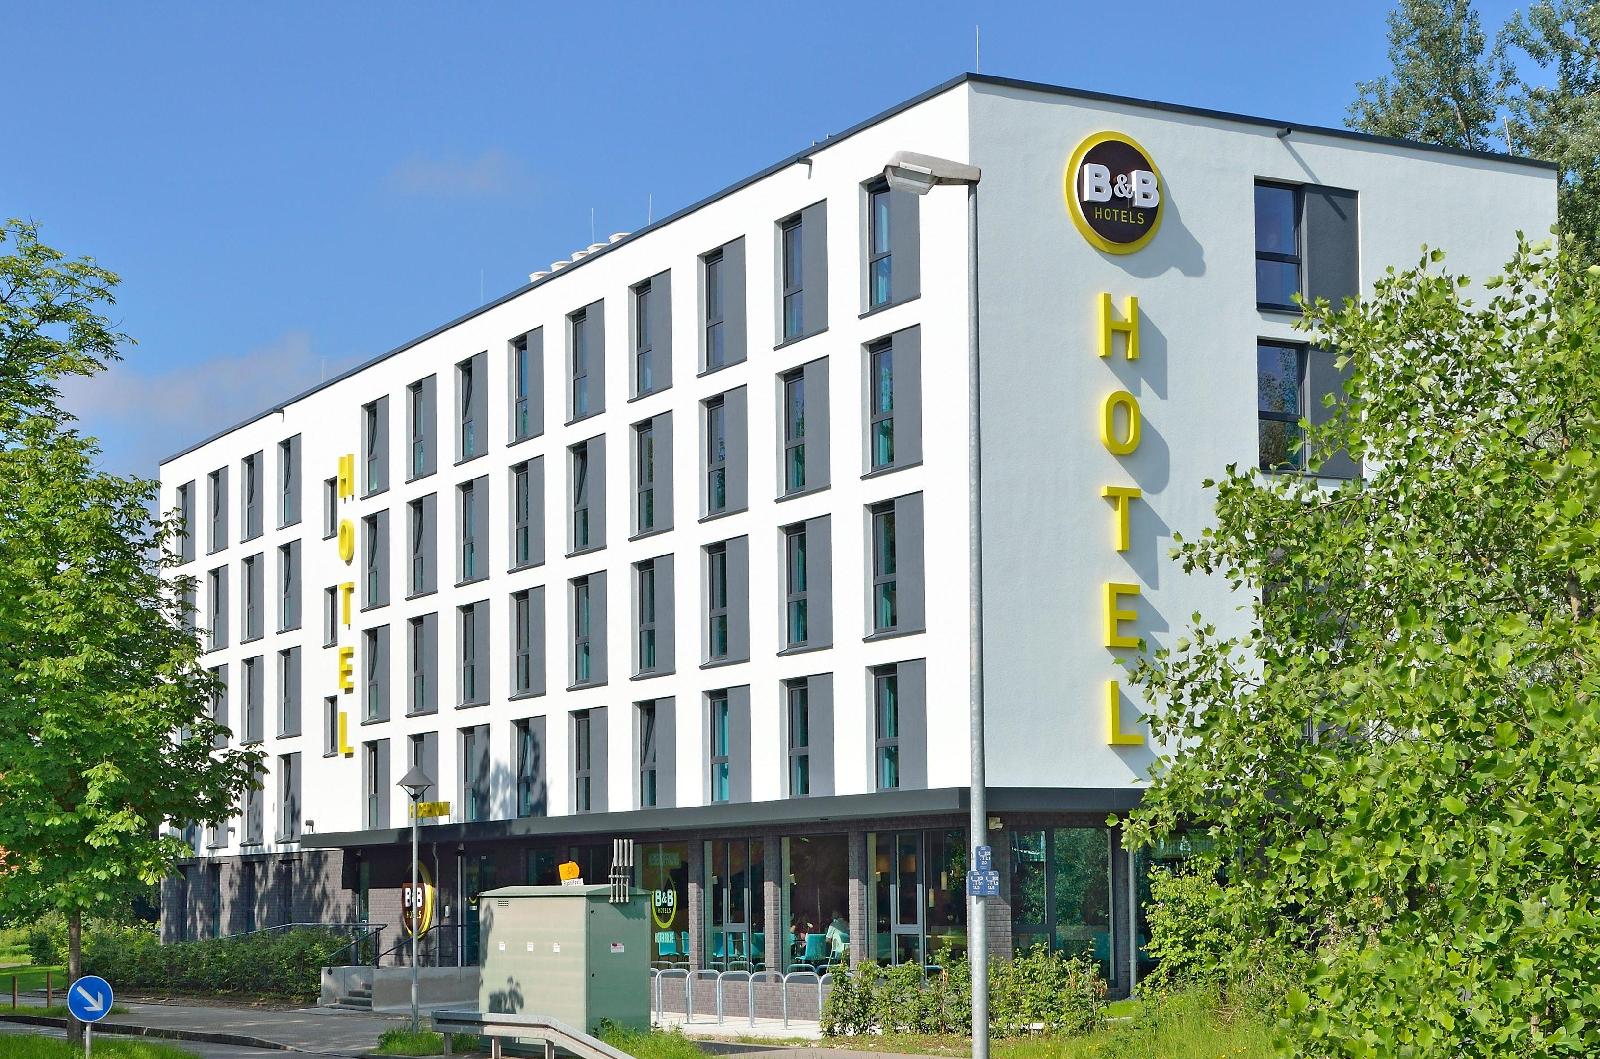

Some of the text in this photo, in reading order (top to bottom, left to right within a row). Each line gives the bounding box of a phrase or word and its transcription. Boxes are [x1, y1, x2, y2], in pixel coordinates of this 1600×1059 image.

[1083, 163, 1160, 208] B&B
[1094, 207, 1145, 225] HOTELS
[1098, 292, 1145, 746] HOTEL
[338, 453, 355, 754] HOTEL
[404, 887, 423, 908] BB
[655, 889, 674, 907] B&B
